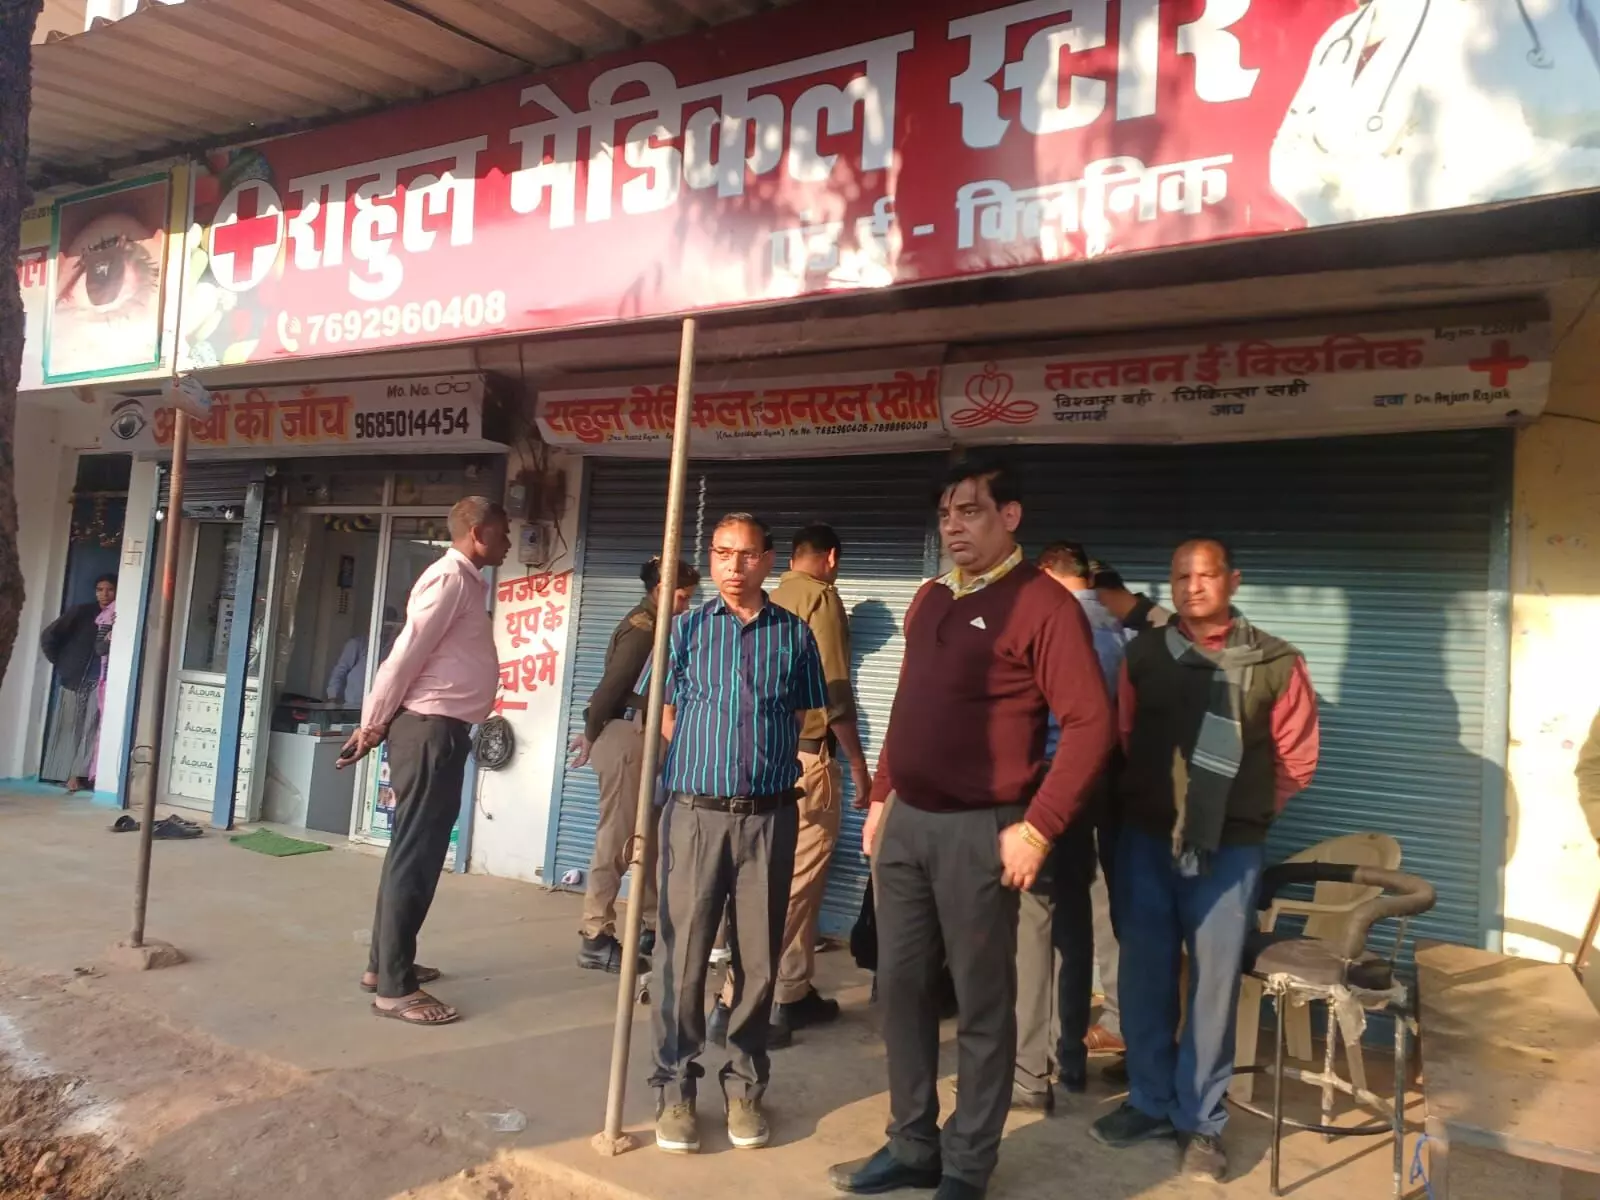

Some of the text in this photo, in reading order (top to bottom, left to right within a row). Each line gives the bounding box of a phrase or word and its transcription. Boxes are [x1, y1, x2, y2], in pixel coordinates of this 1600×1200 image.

[289, 135, 488, 301] राहुल
[509, 30, 915, 229] मेडिकल
[956, 154, 1234, 249] क्लिनिक
[307, 290, 506, 345] 7692960408
[234, 390, 276, 439] की
[279, 386, 352, 437] जाँच
[355, 407, 470, 439] 9685014454
[544, 396, 626, 444] राहुल
[760, 383, 874, 427] जनरल
[543, 601, 565, 632] के
